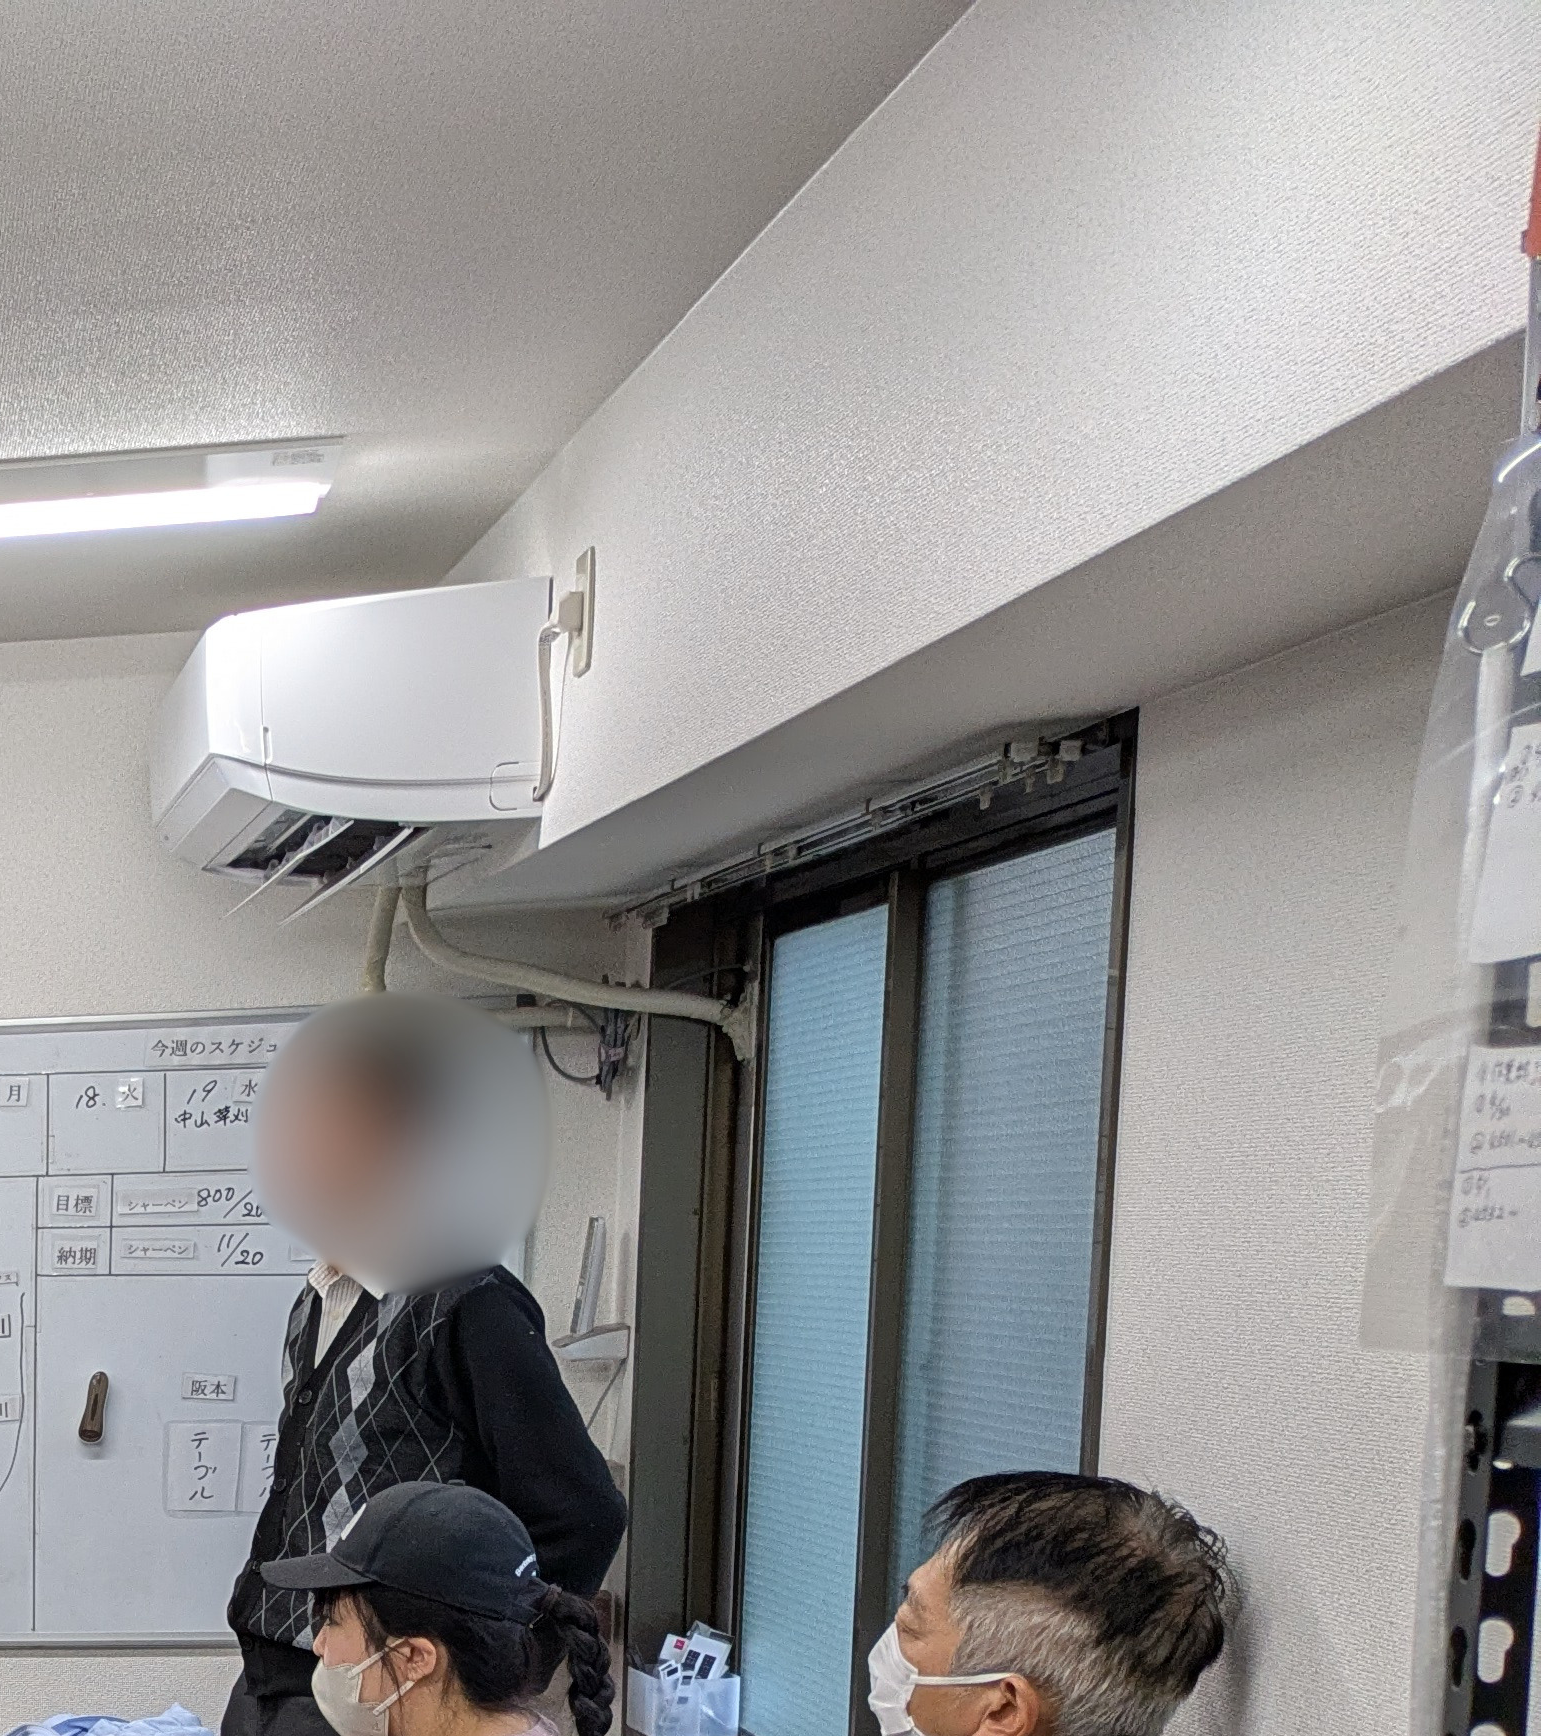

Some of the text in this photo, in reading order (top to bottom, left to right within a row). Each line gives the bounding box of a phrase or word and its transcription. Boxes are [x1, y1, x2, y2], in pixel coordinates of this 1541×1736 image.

[5, 1083, 23, 1104] 月
[240, 1078, 259, 1098] 水
[55, 1194, 94, 1215] 目標
[127, 1198, 190, 1212] シャーペン
[56, 1232, 264, 1268] 納期 シャーペン 11/20
[190, 1379, 227, 1396] 阪本
[188, 1431, 218, 1501] テーブル
